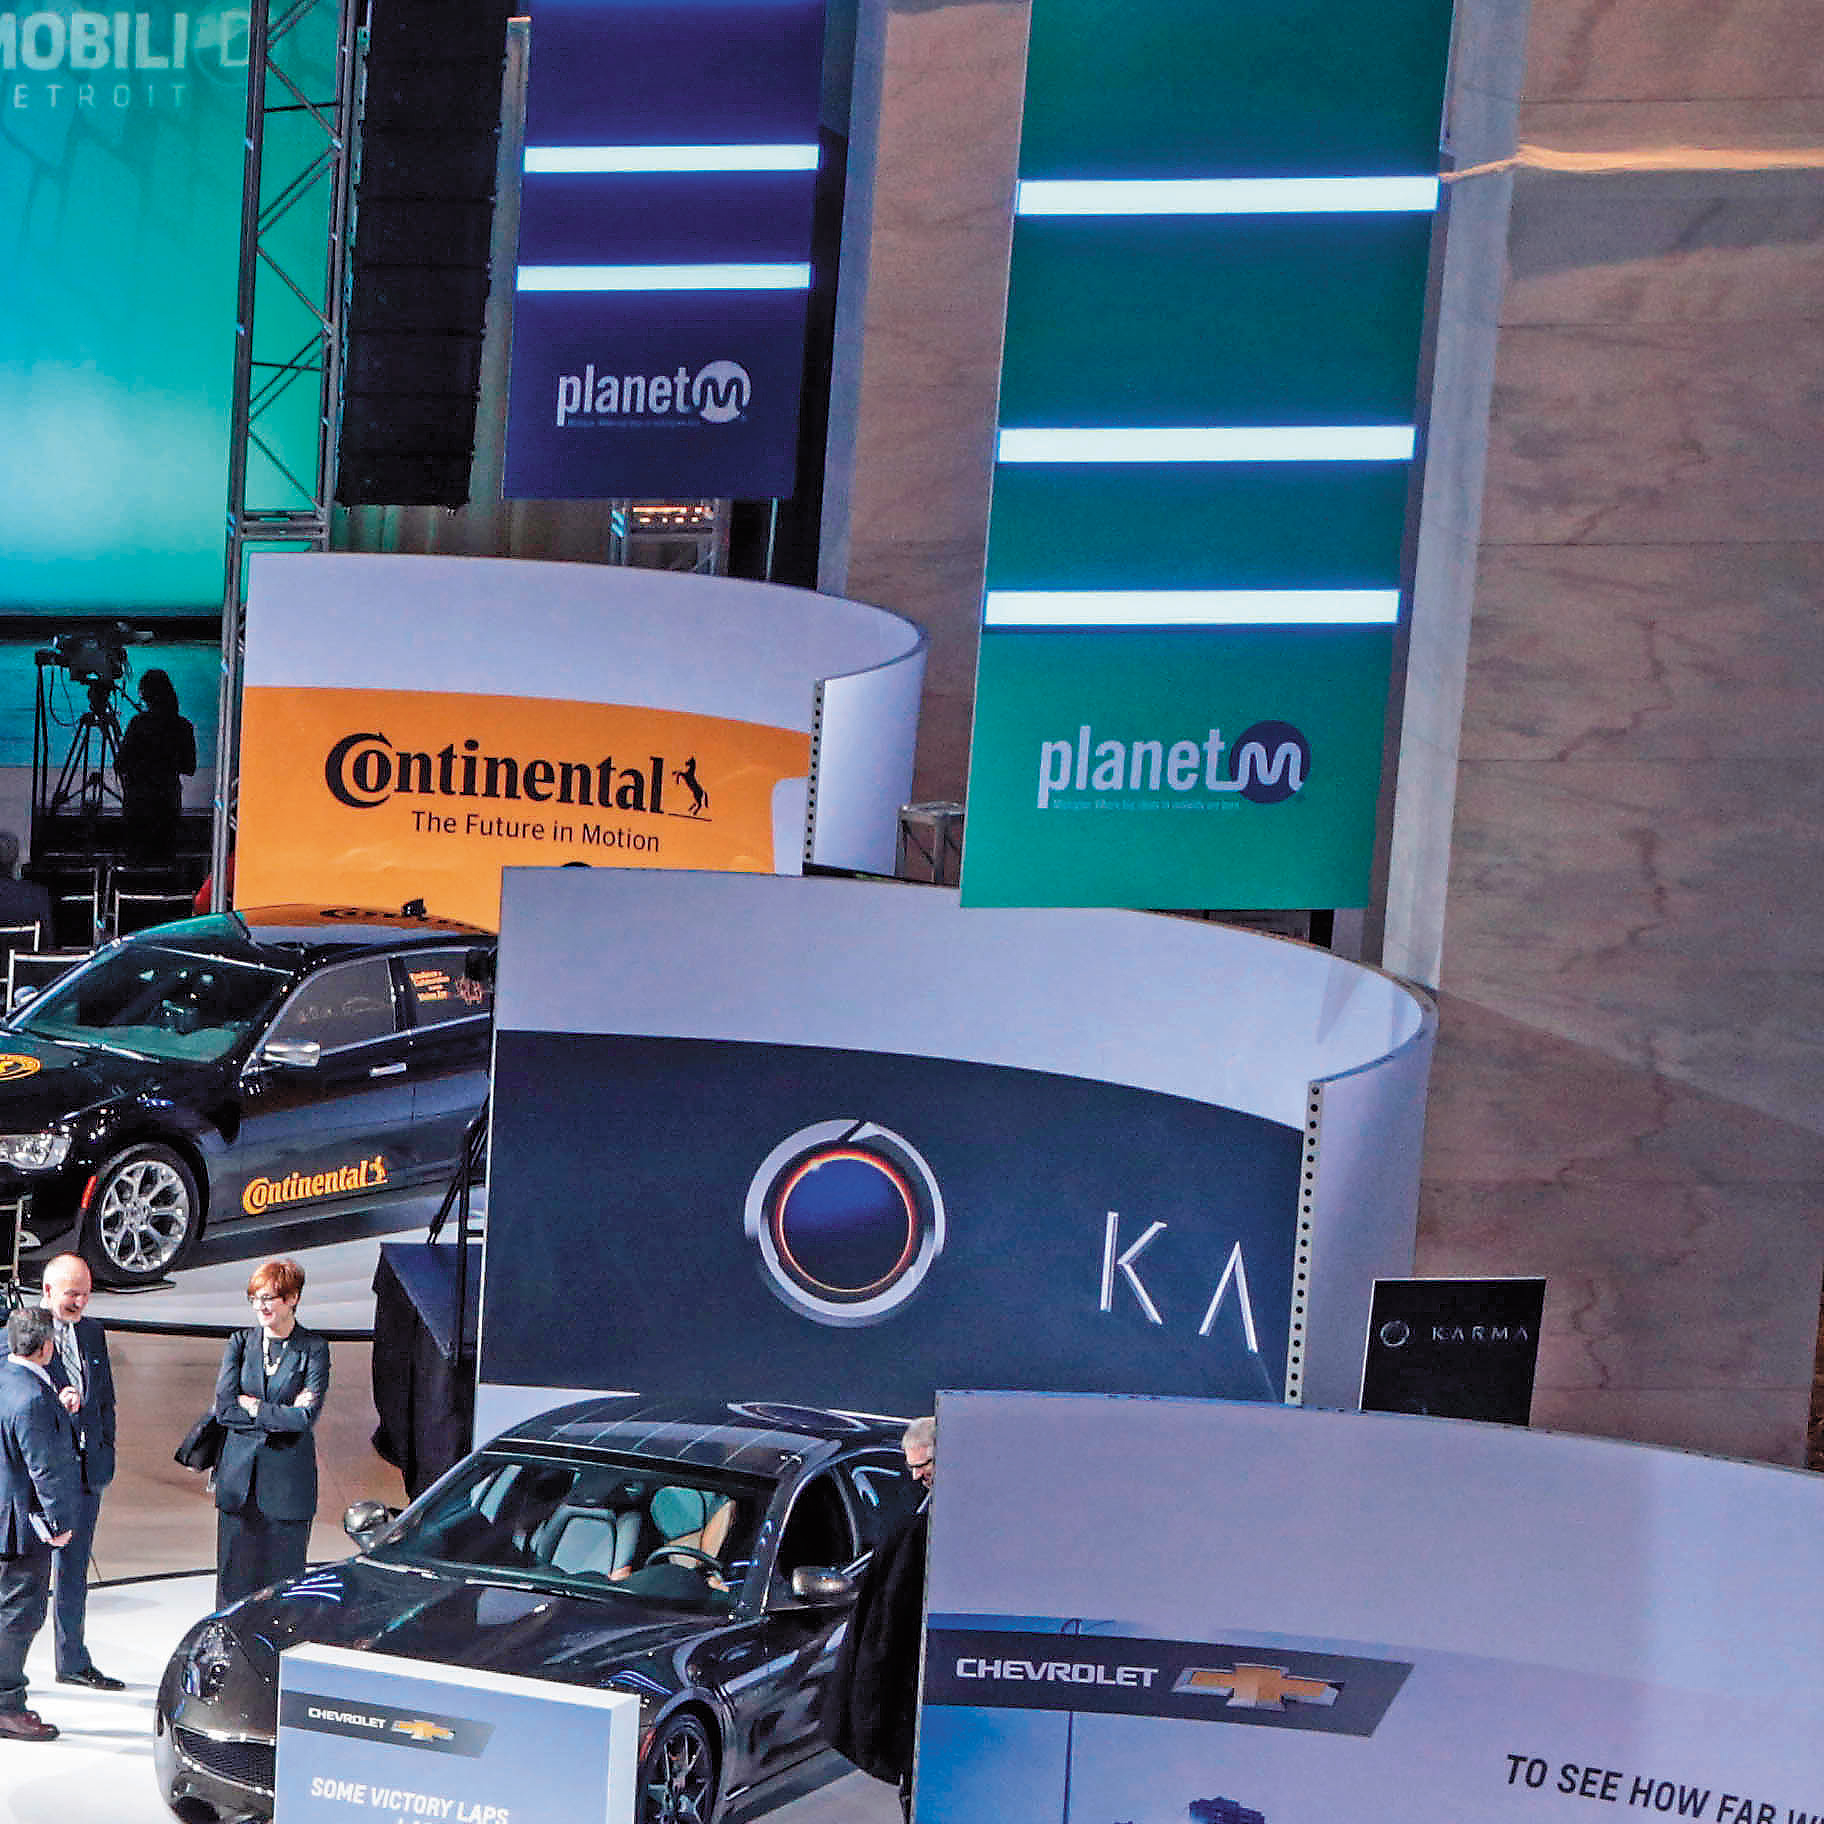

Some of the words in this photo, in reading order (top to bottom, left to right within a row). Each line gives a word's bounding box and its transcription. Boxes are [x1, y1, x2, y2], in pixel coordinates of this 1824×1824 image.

[325, 732, 664, 815] Continental
[412, 810, 457, 833] The
[466, 814, 545, 840] Future
[553, 820, 572, 843] in
[582, 823, 659, 852] Motion
[243, 1160, 368, 1215] Continental
[1432, 1325, 1528, 1342] KARMA
[955, 1657, 1158, 1688] CHEVROLET
[308, 1707, 386, 1729] CHEVROLET
[311, 1777, 367, 1804] SOME
[371, 1787, 454, 1818] VICTORY
[1507, 1754, 1547, 1788] TO
[1557, 1763, 1622, 1801] SEE
[1629, 1776, 1710, 1818] HOW
